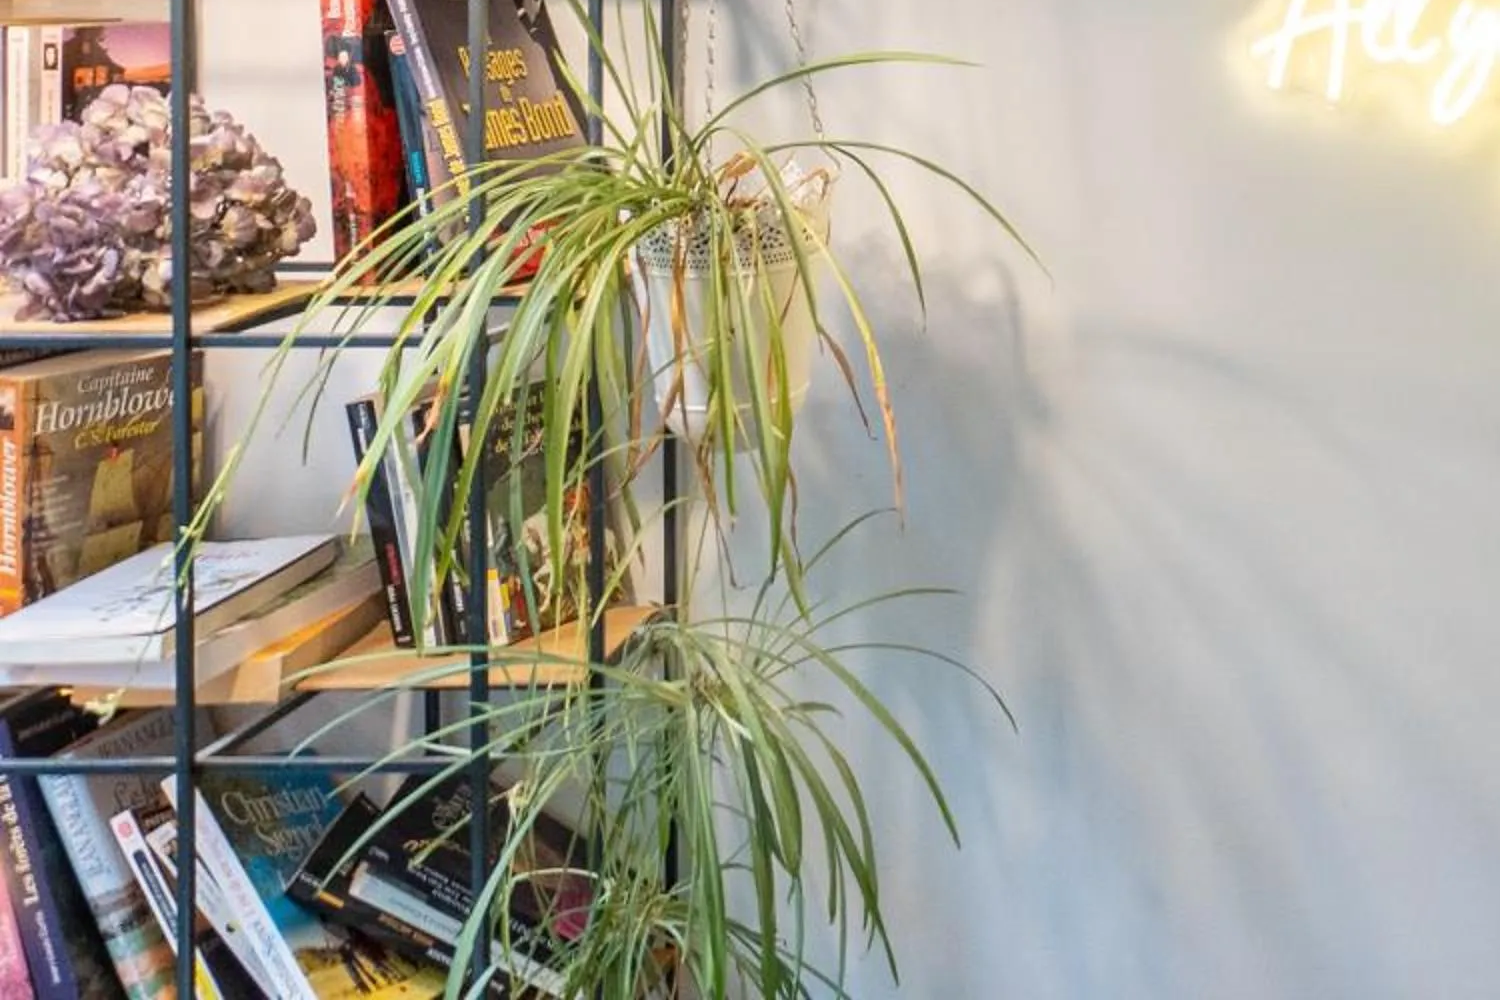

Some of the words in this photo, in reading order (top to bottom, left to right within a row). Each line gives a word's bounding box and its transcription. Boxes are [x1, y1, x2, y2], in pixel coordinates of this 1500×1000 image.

[517, 90, 576, 142] Bond
[77, 365, 156, 394] Capitaine
[221, 784, 328, 826] Christian
